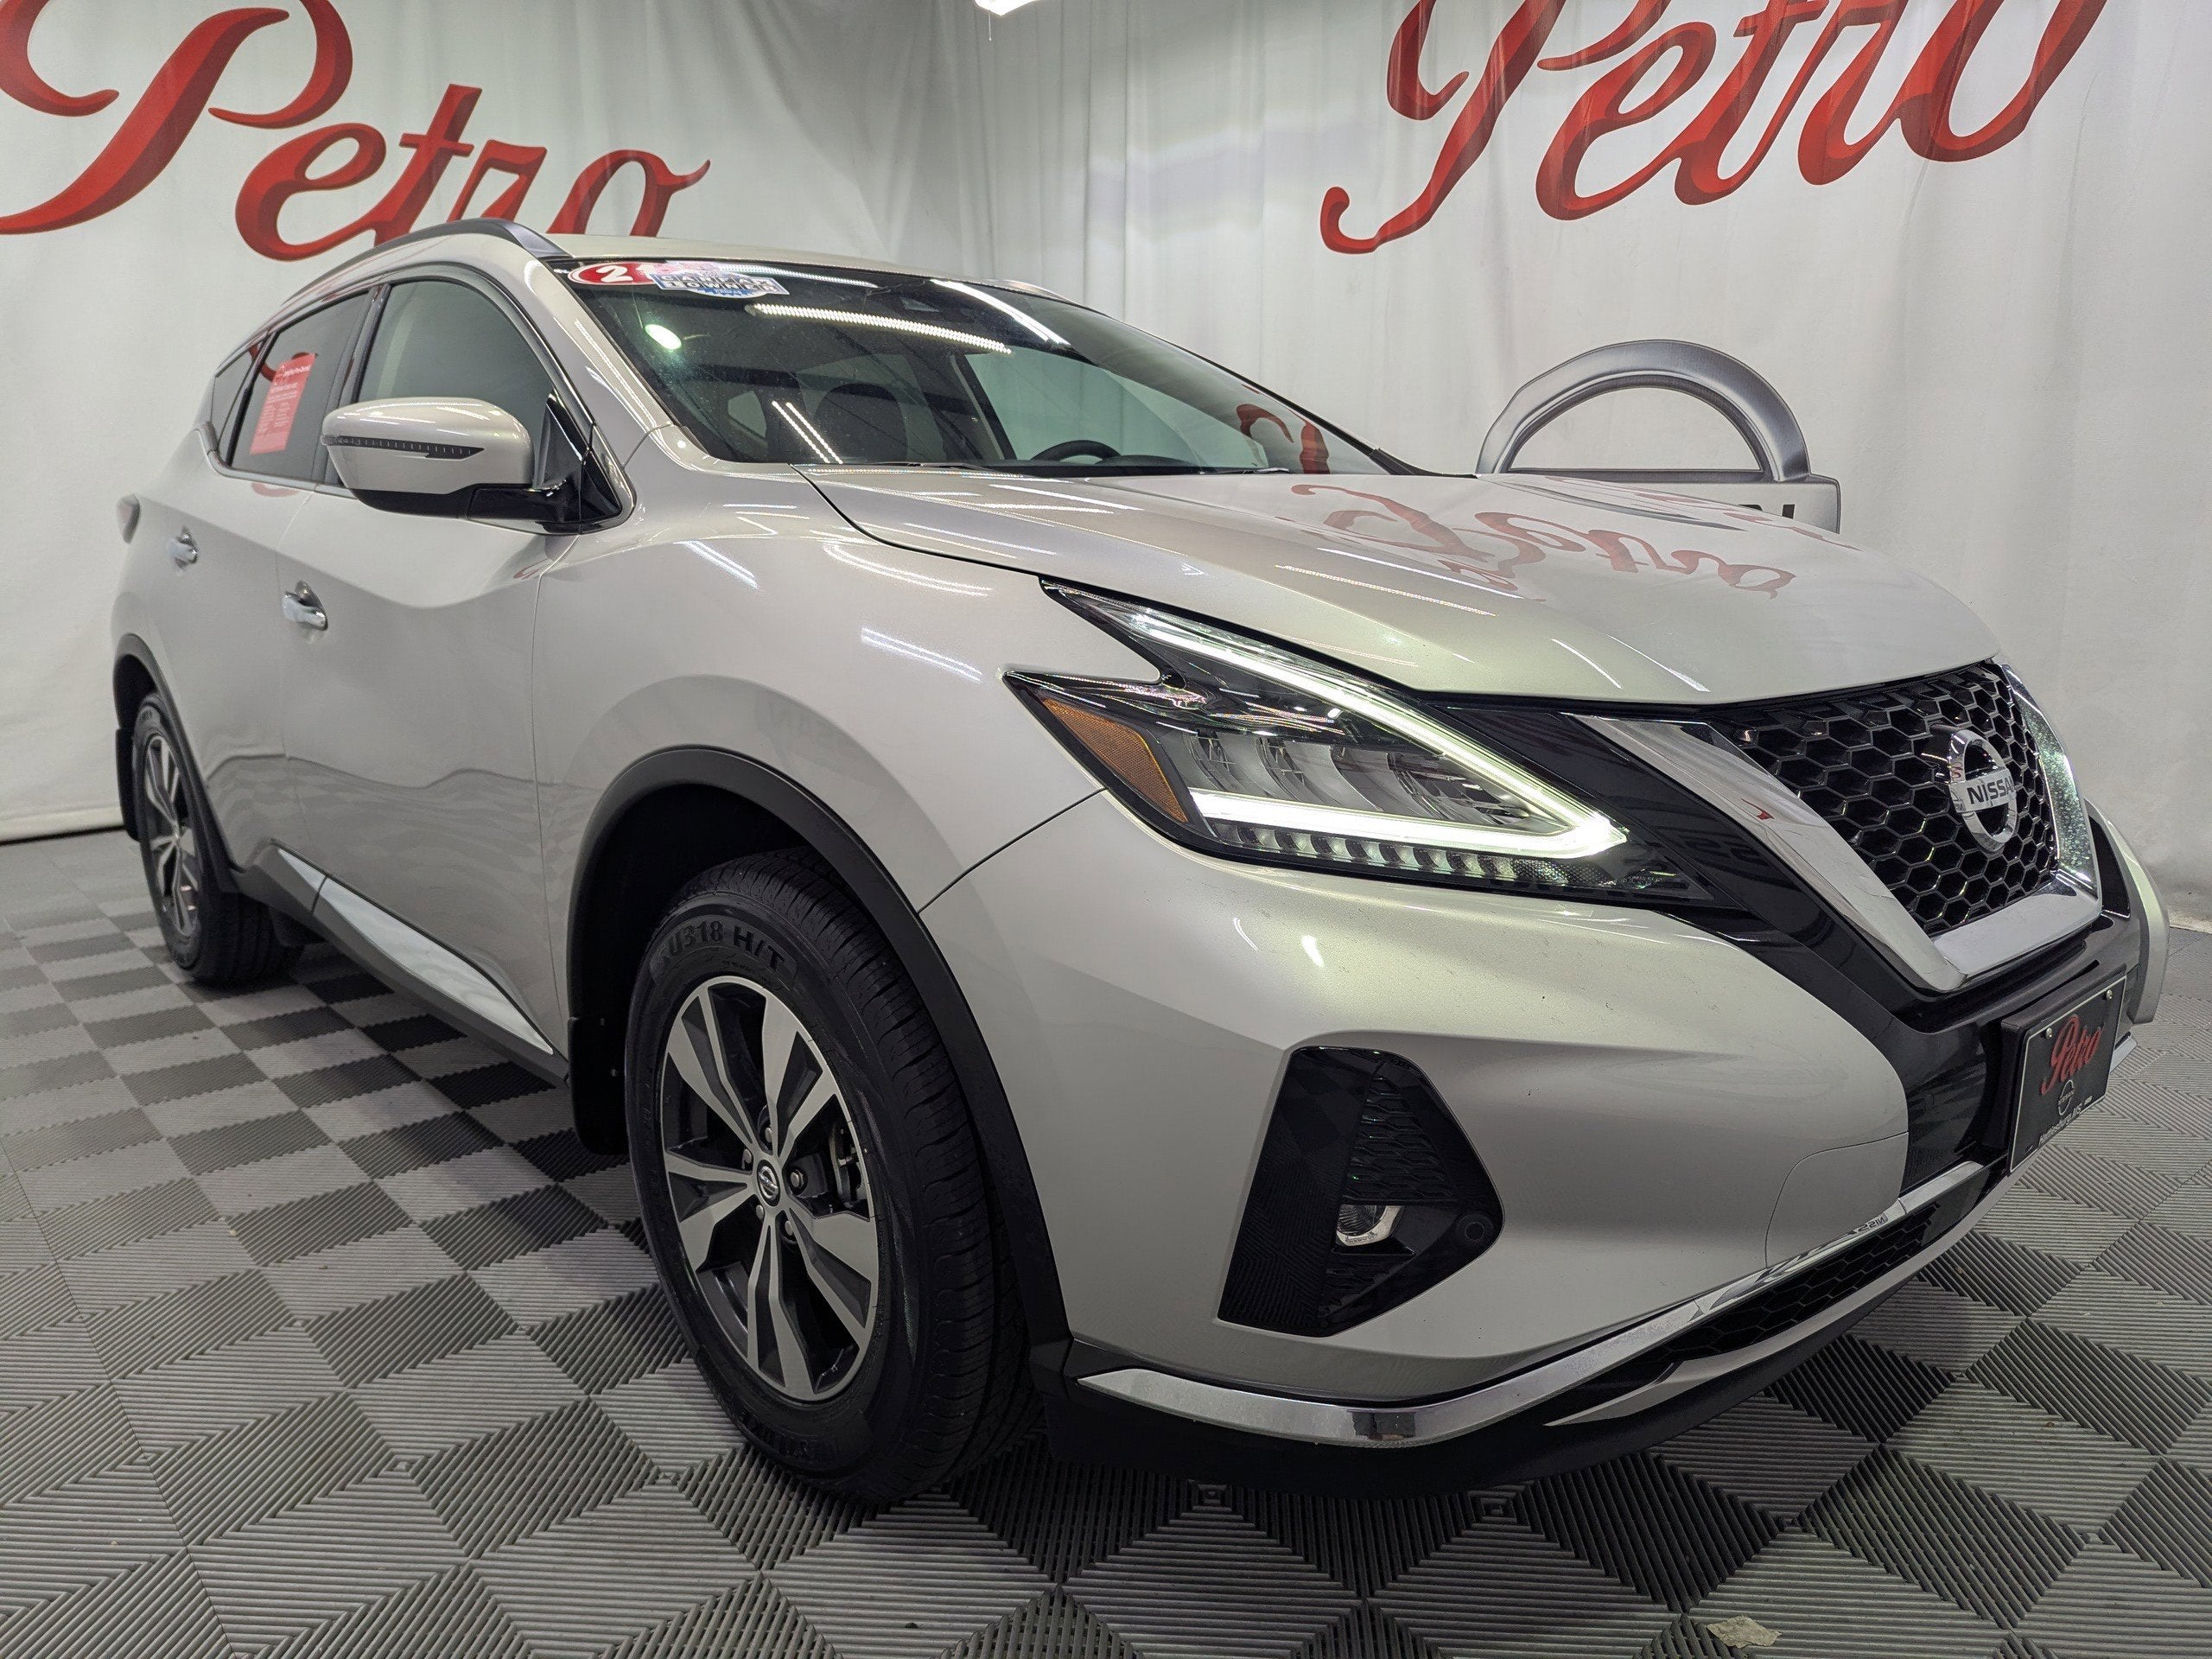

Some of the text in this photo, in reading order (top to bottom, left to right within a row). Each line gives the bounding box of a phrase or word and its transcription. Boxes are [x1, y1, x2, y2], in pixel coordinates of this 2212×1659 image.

[0, 0, 710, 262] Petro
[1319, 0, 2107, 254] Petro
[660, 275, 771, 286] CARFAX
[686, 282, 778, 292] OWNER
[733, 925, 785, 972] H/T
[2039, 1014, 2106, 1096] Petro
